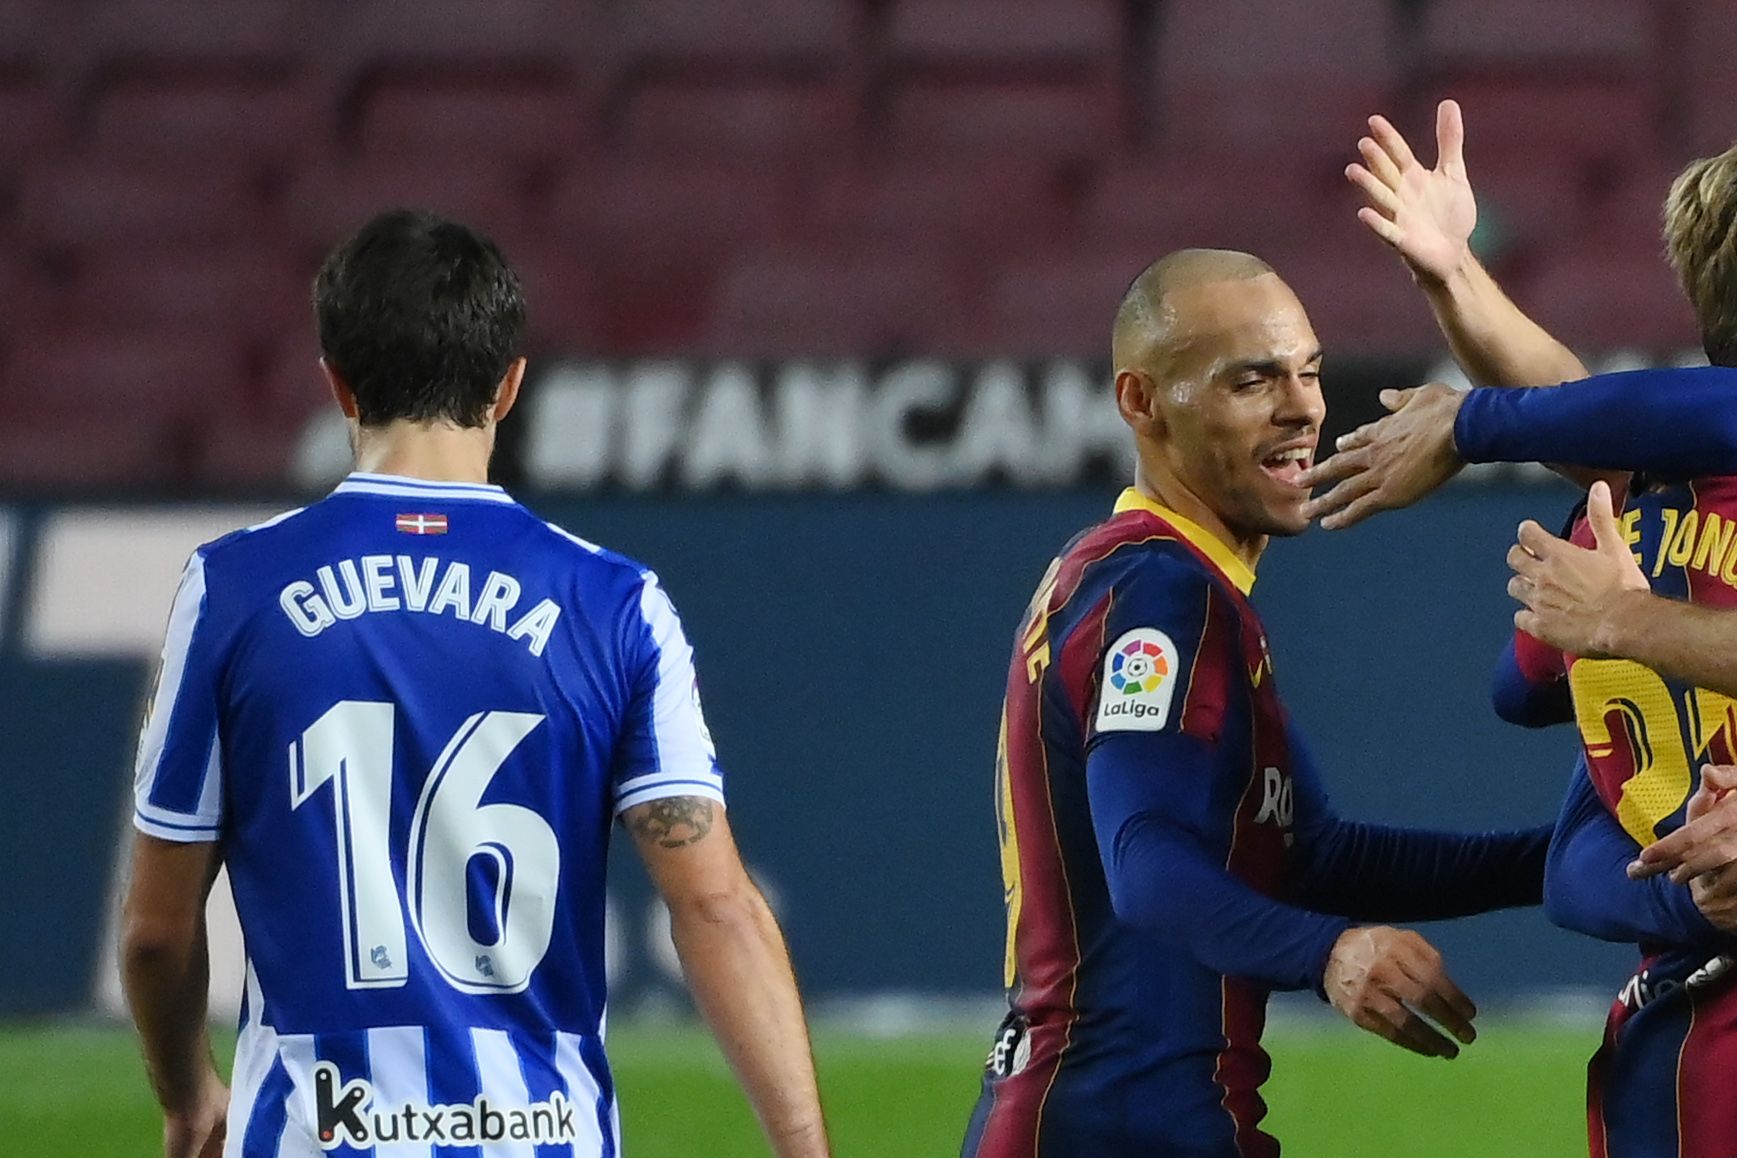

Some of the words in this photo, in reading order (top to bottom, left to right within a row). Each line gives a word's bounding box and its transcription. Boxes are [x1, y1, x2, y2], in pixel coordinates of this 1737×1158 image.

[279, 553, 562, 658] GUEVARA
[1104, 699, 1159, 718] LaLiga
[289, 700, 560, 995] 16
[313, 1067, 576, 1143] Kutxabank
